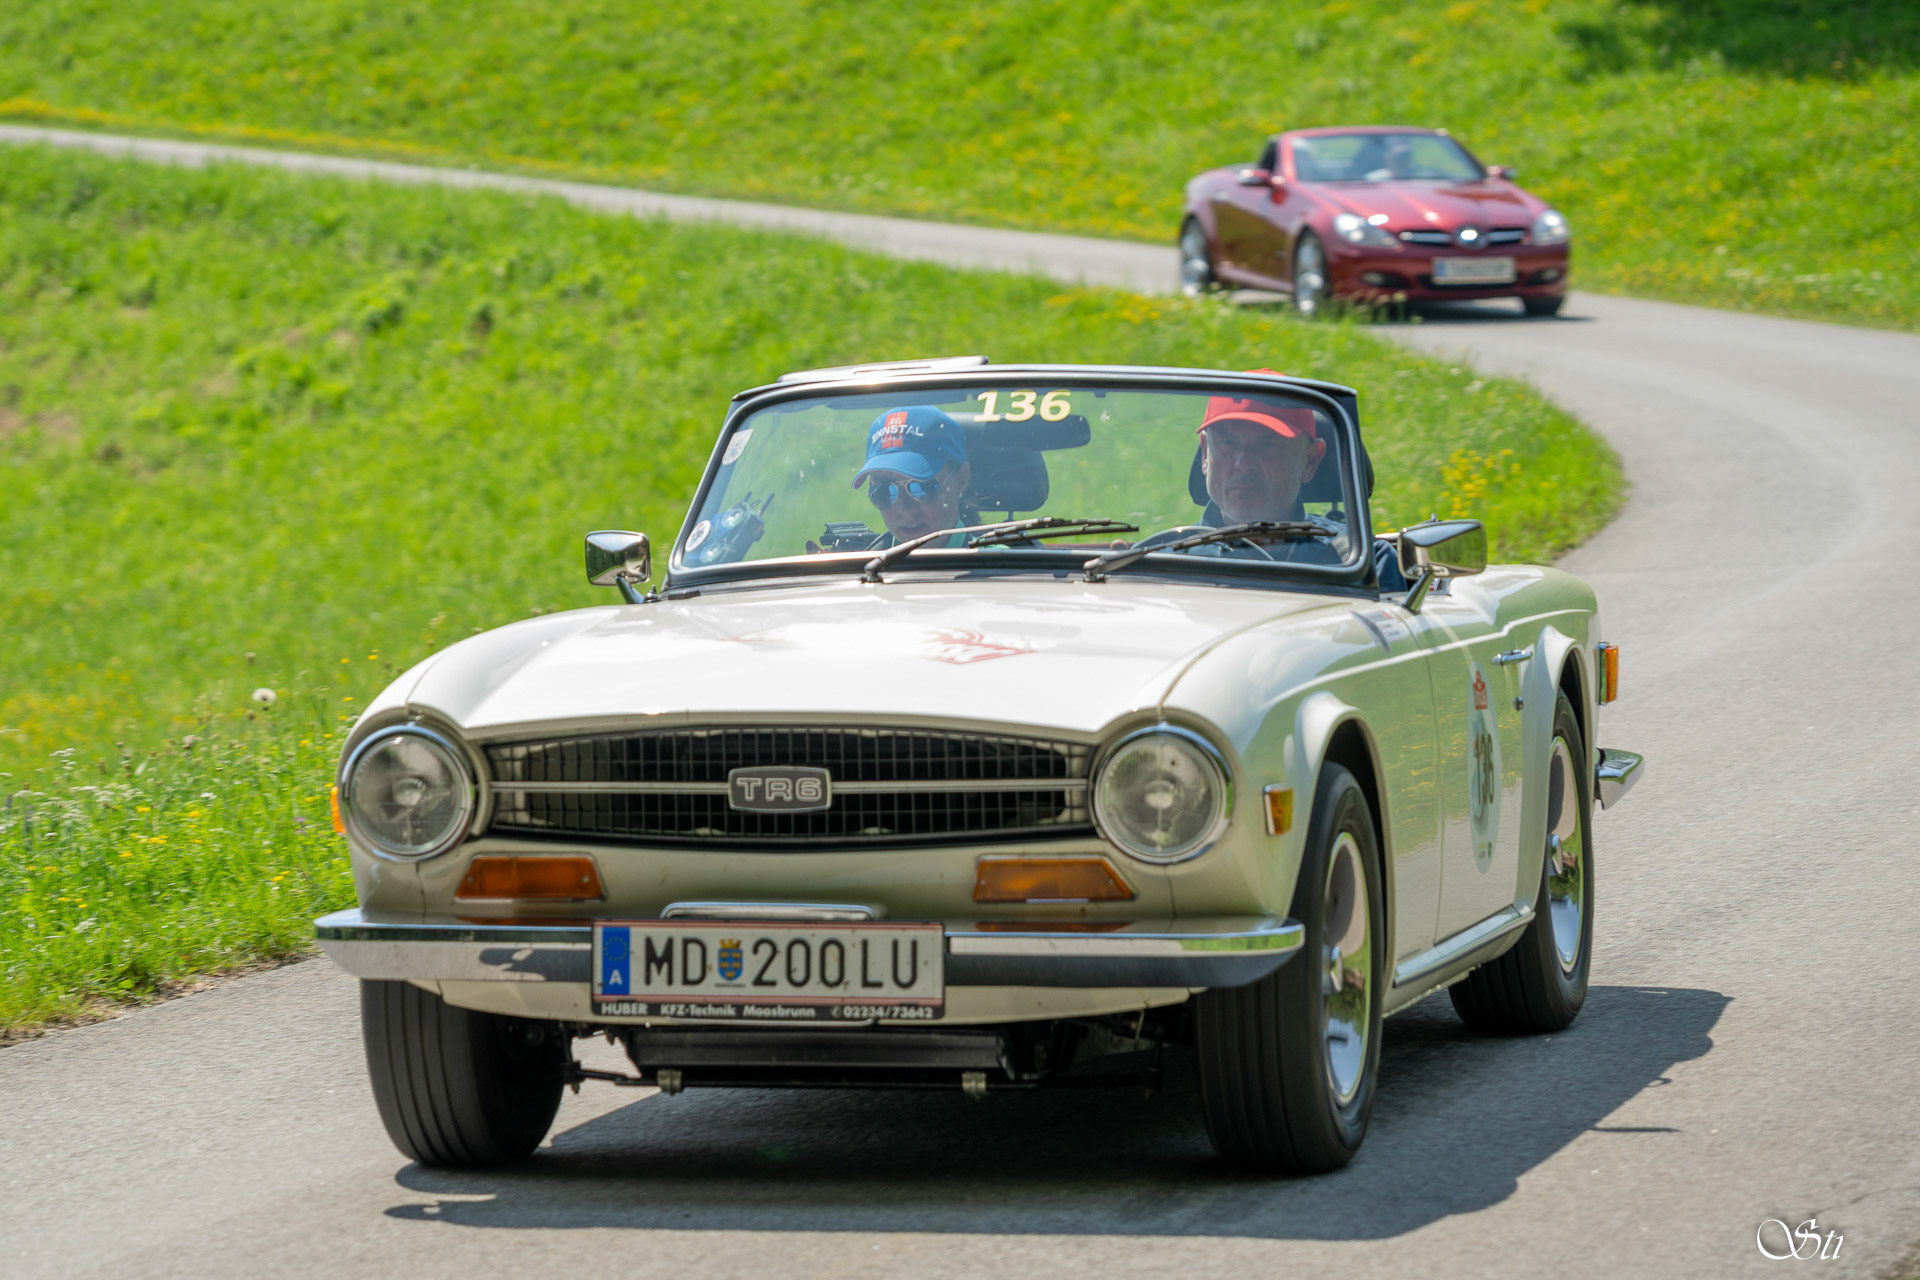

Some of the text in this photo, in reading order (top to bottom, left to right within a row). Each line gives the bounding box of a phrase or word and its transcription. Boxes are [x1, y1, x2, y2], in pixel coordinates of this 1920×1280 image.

[974, 389, 1071, 422] 136
[872, 424, 924, 444] ENNSTAL
[736, 777, 823, 802] TR6
[645, 936, 707, 986] MD
[609, 969, 623, 985] A
[601, 1003, 648, 1016] HUBER
[660, 1003, 737, 1017] KFZ-Technik
[743, 1004, 816, 1018] Moosbrunn
